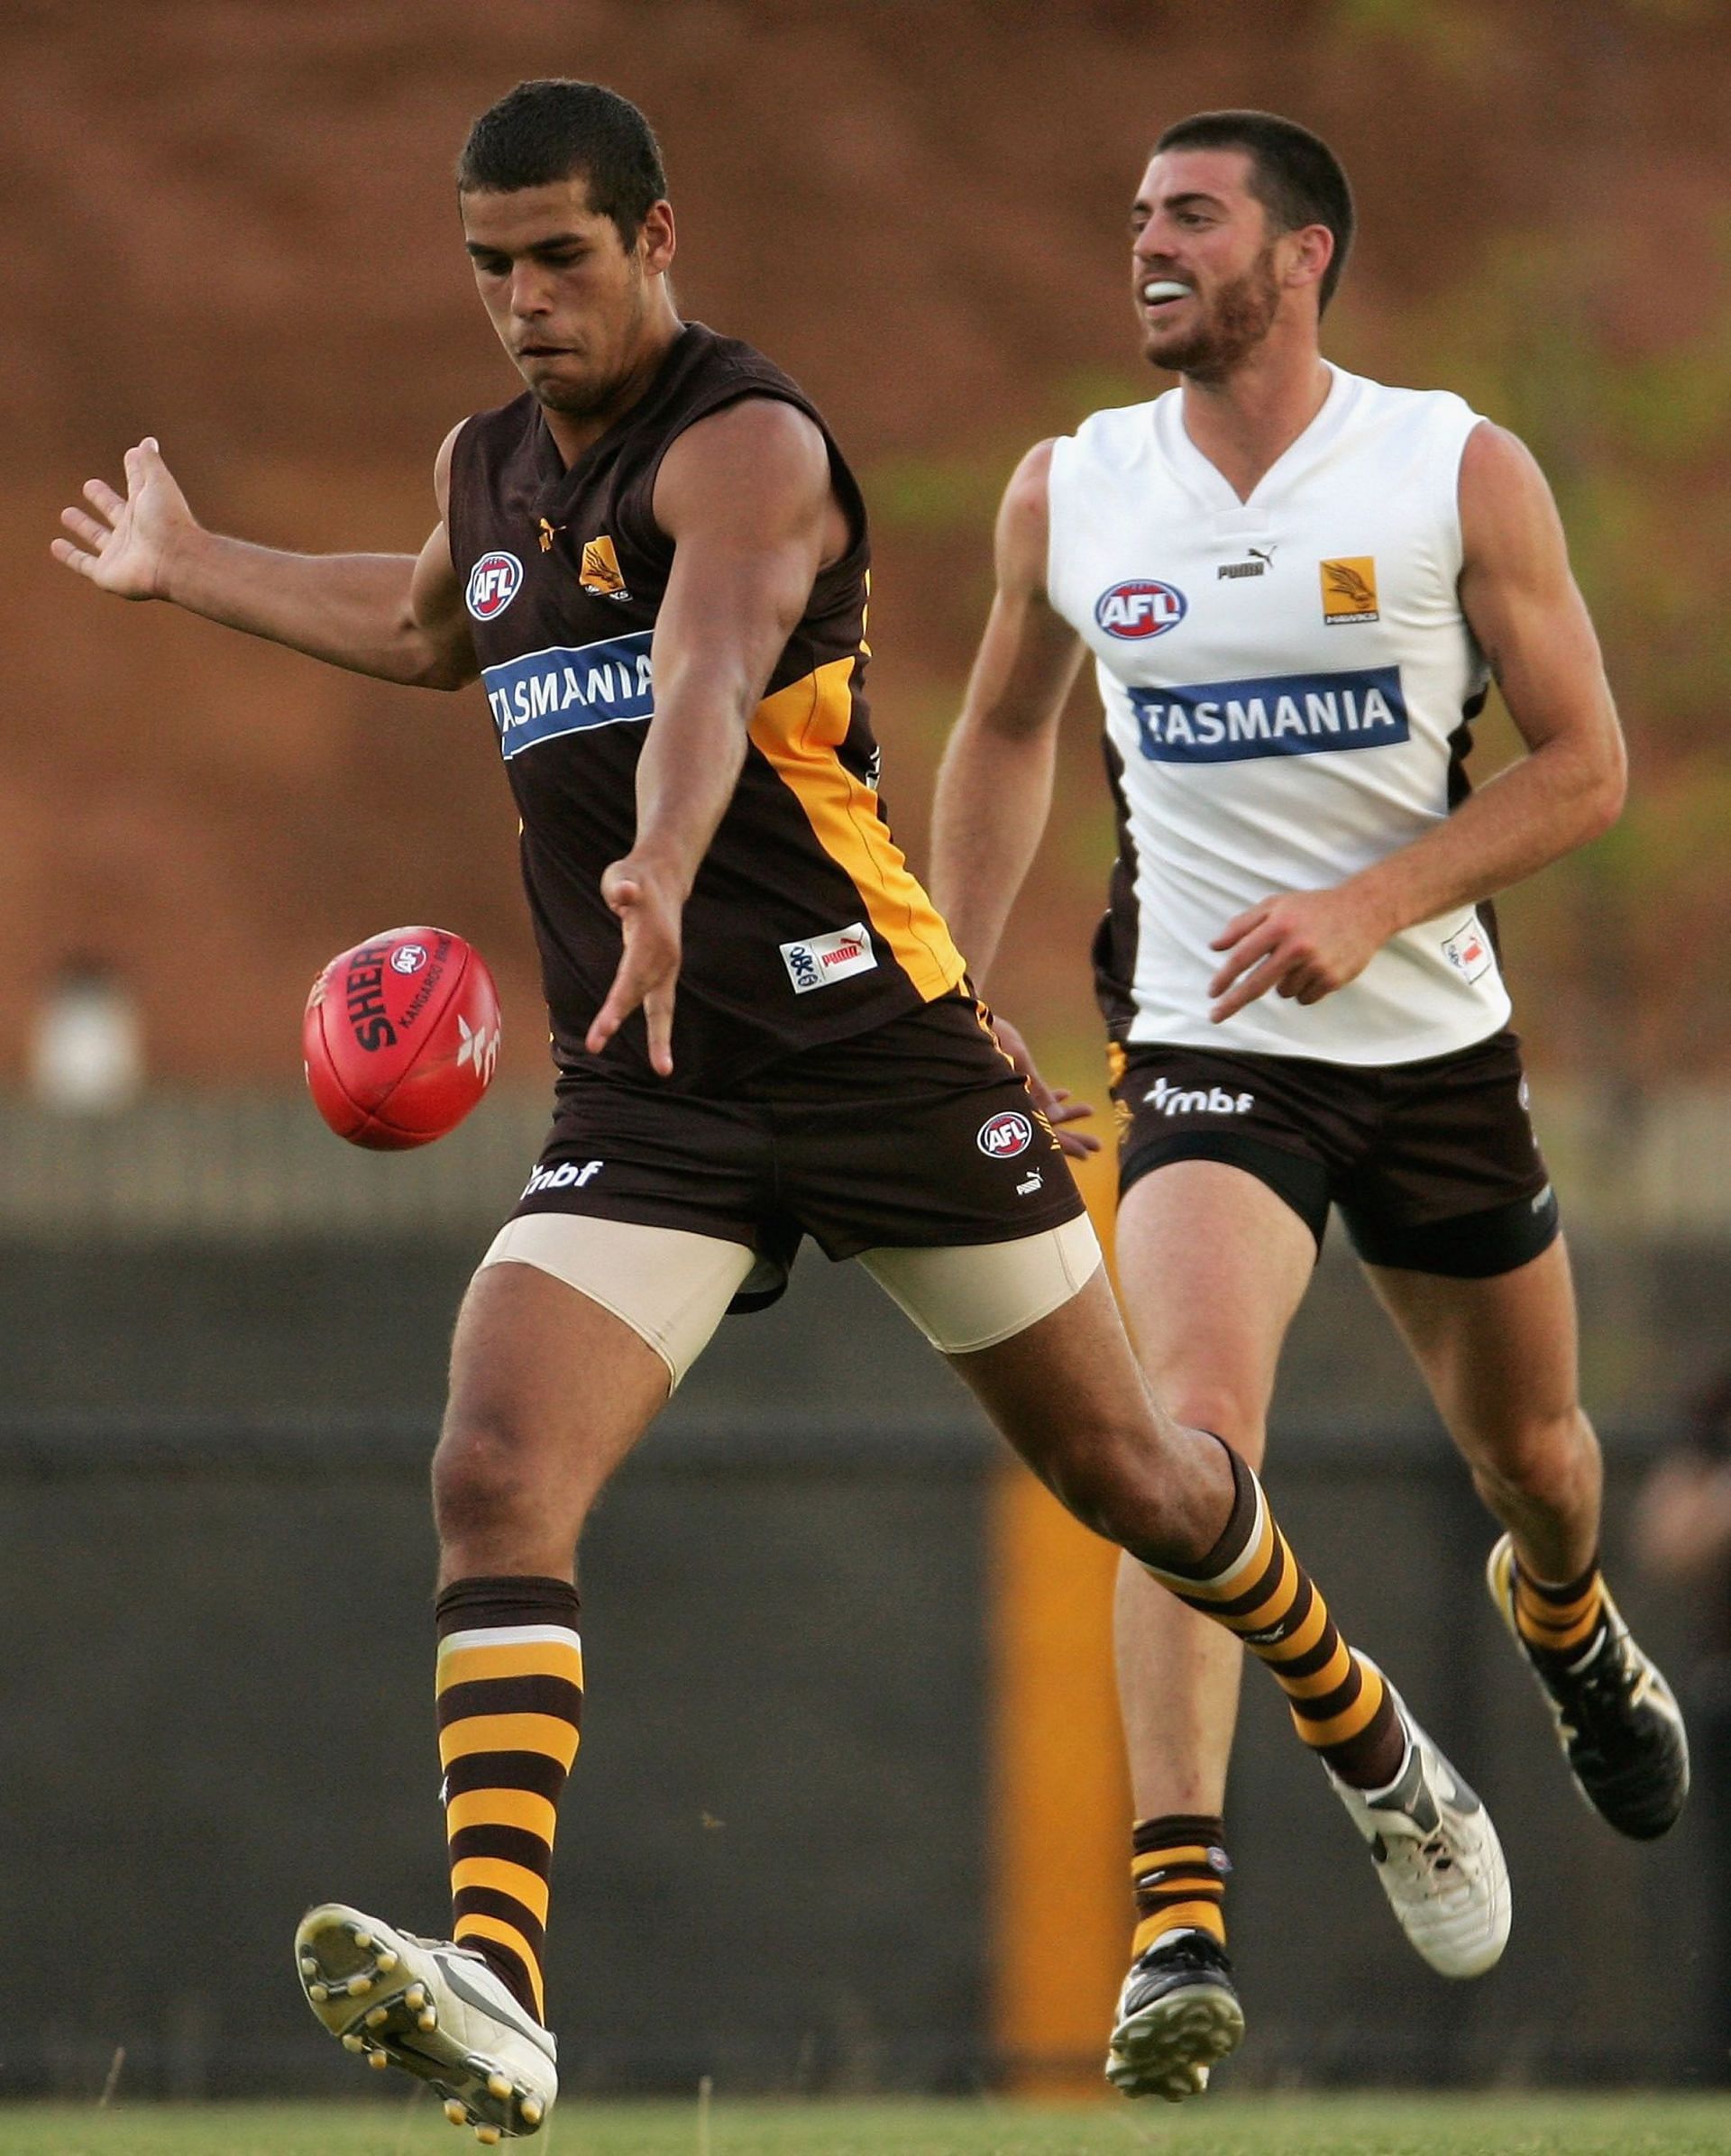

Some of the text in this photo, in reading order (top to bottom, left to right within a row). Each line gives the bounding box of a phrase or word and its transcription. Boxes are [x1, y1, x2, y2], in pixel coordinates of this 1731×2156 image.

[472, 567, 512, 606] AFL
[1102, 592, 1180, 627] AFL
[488, 653, 655, 733] TASMANIA
[1142, 688, 1396, 745] TASMANIA
[397, 946, 423, 973] AFL
[346, 940, 398, 1052] SHER
[1164, 1086, 1255, 1116] mbf
[988, 1120, 1028, 1152] AFL
